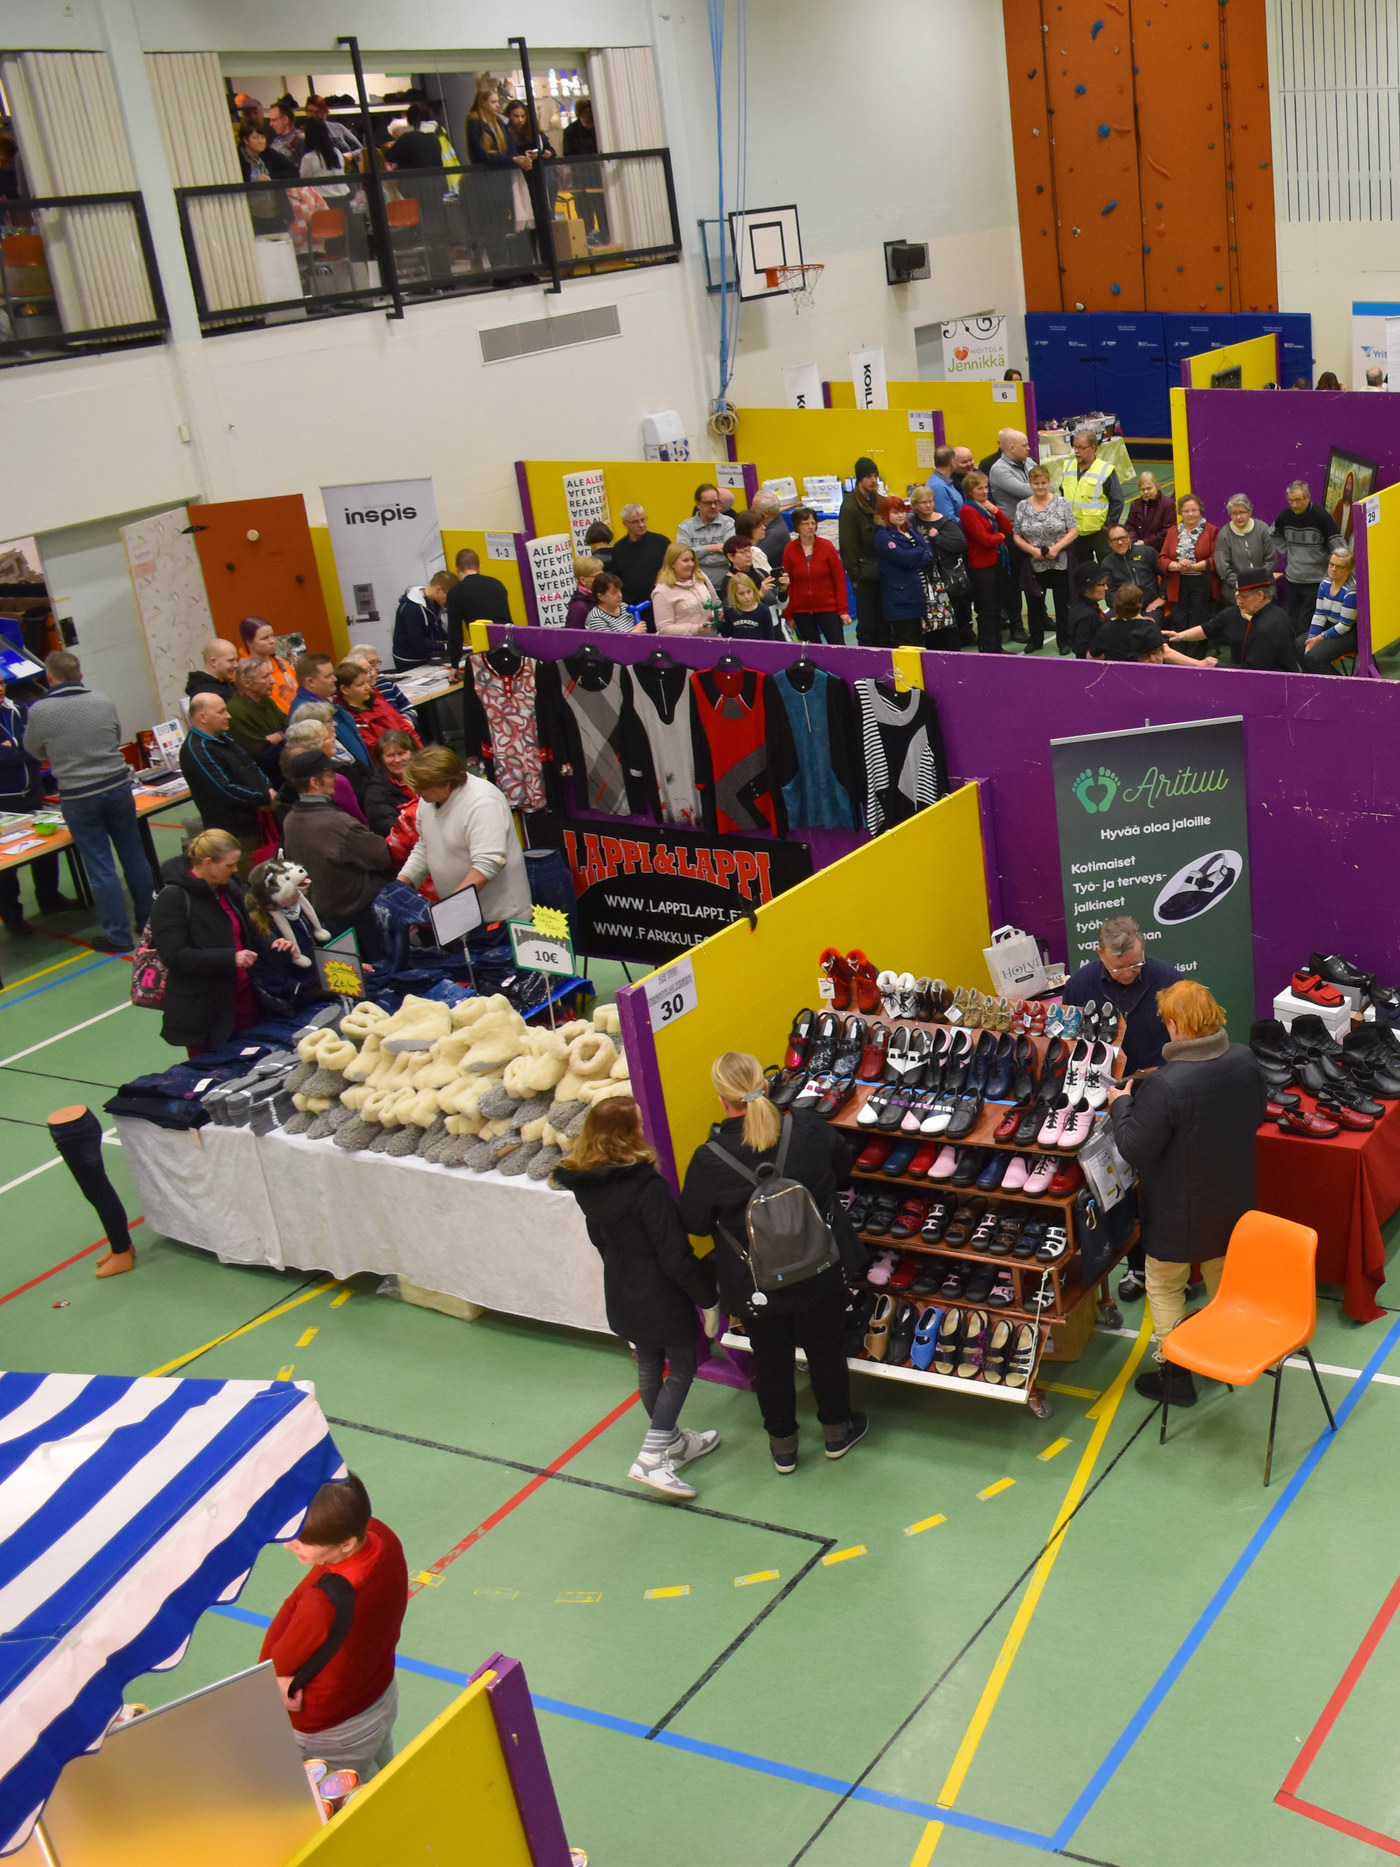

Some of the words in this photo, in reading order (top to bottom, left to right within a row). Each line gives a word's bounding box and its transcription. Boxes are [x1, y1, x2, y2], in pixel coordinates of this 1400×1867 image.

[971, 346, 1004, 355] HOITOLA
[948, 354, 1005, 373] Jennikkä
[1001, 391, 1008, 400] 6
[918, 422, 925, 430] 5
[728, 477, 735, 486] 4
[344, 503, 417, 526] inspis
[1368, 511, 1376, 523] 29
[1123, 766, 1229, 808] Arituu
[1100, 824, 1141, 841] Hyvää
[1143, 822, 1170, 834] oloa
[1172, 815, 1212, 833] jaloille
[563, 829, 774, 906] LAPPI&LAPPI
[1071, 855, 1137, 875] Kotimaiset
[1073, 881, 1101, 895] Työ-
[1102, 878, 1115, 892] ja
[1117, 872, 1168, 888] terveys-
[1073, 896, 1126, 916] jalkineet
[535, 950, 559, 964] 10€
[141, 967, 155, 988] R
[660, 993, 684, 1021] 30
